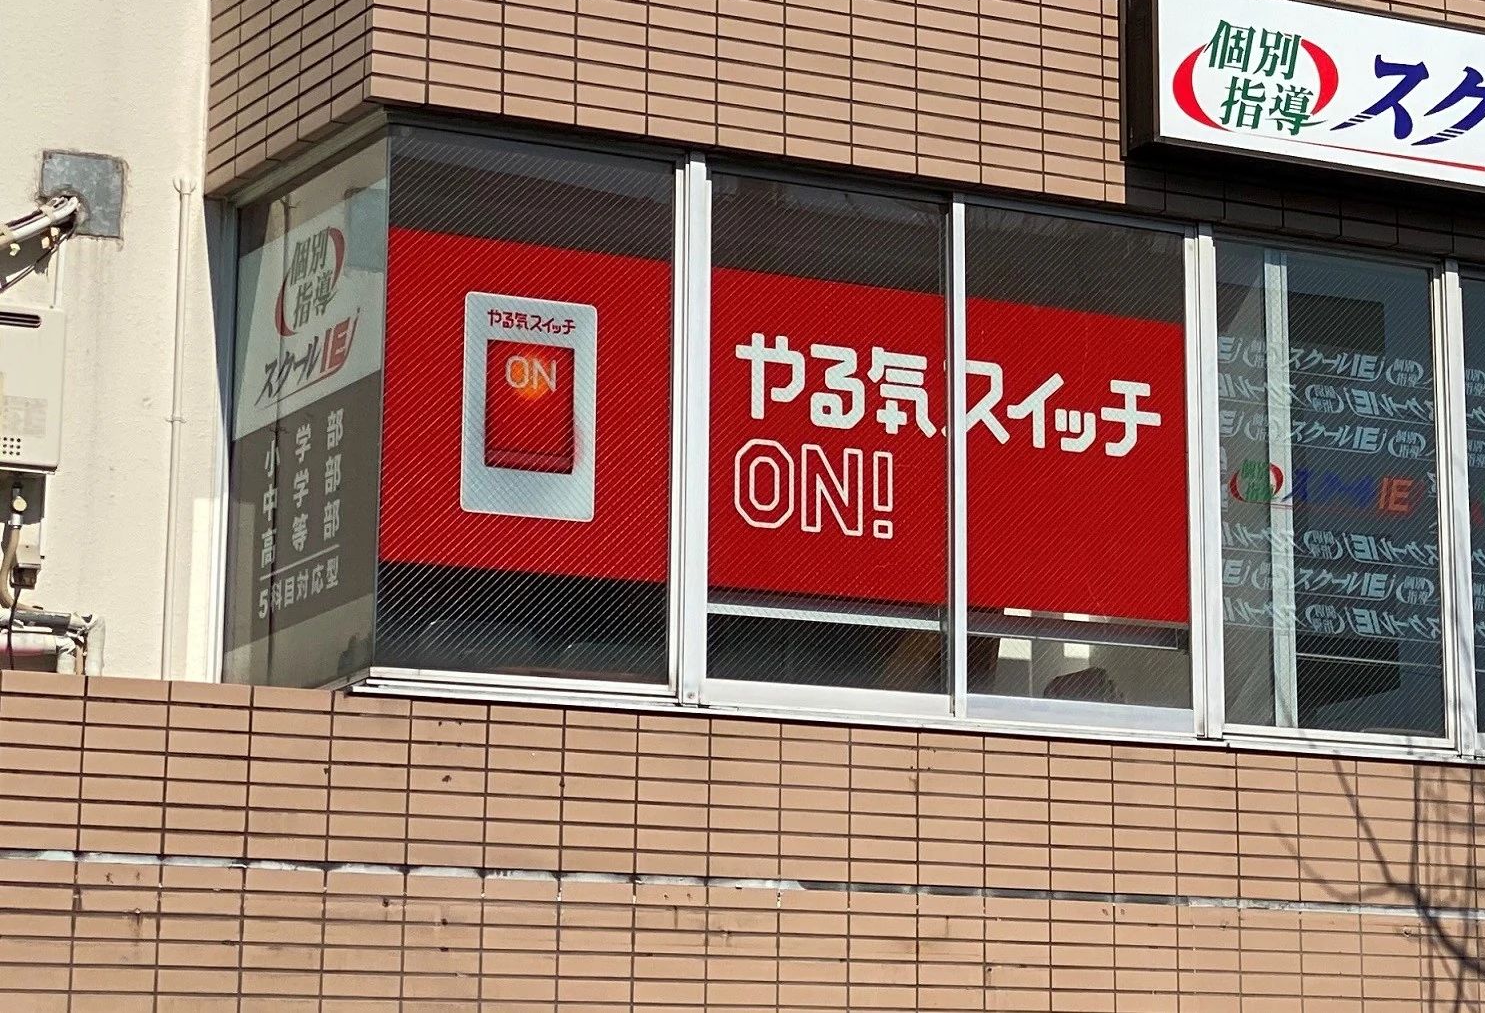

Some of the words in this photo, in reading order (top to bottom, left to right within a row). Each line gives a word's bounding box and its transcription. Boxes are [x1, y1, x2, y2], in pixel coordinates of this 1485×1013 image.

[1207, 18, 1302, 81] 個別
[1219, 74, 1327, 136] 指導
[487, 308, 576, 335] やる気スイッチ
[505, 355, 557, 392] ON
[735, 332, 1162, 457] やる気スイッチ
[734, 438, 894, 540] ON!
